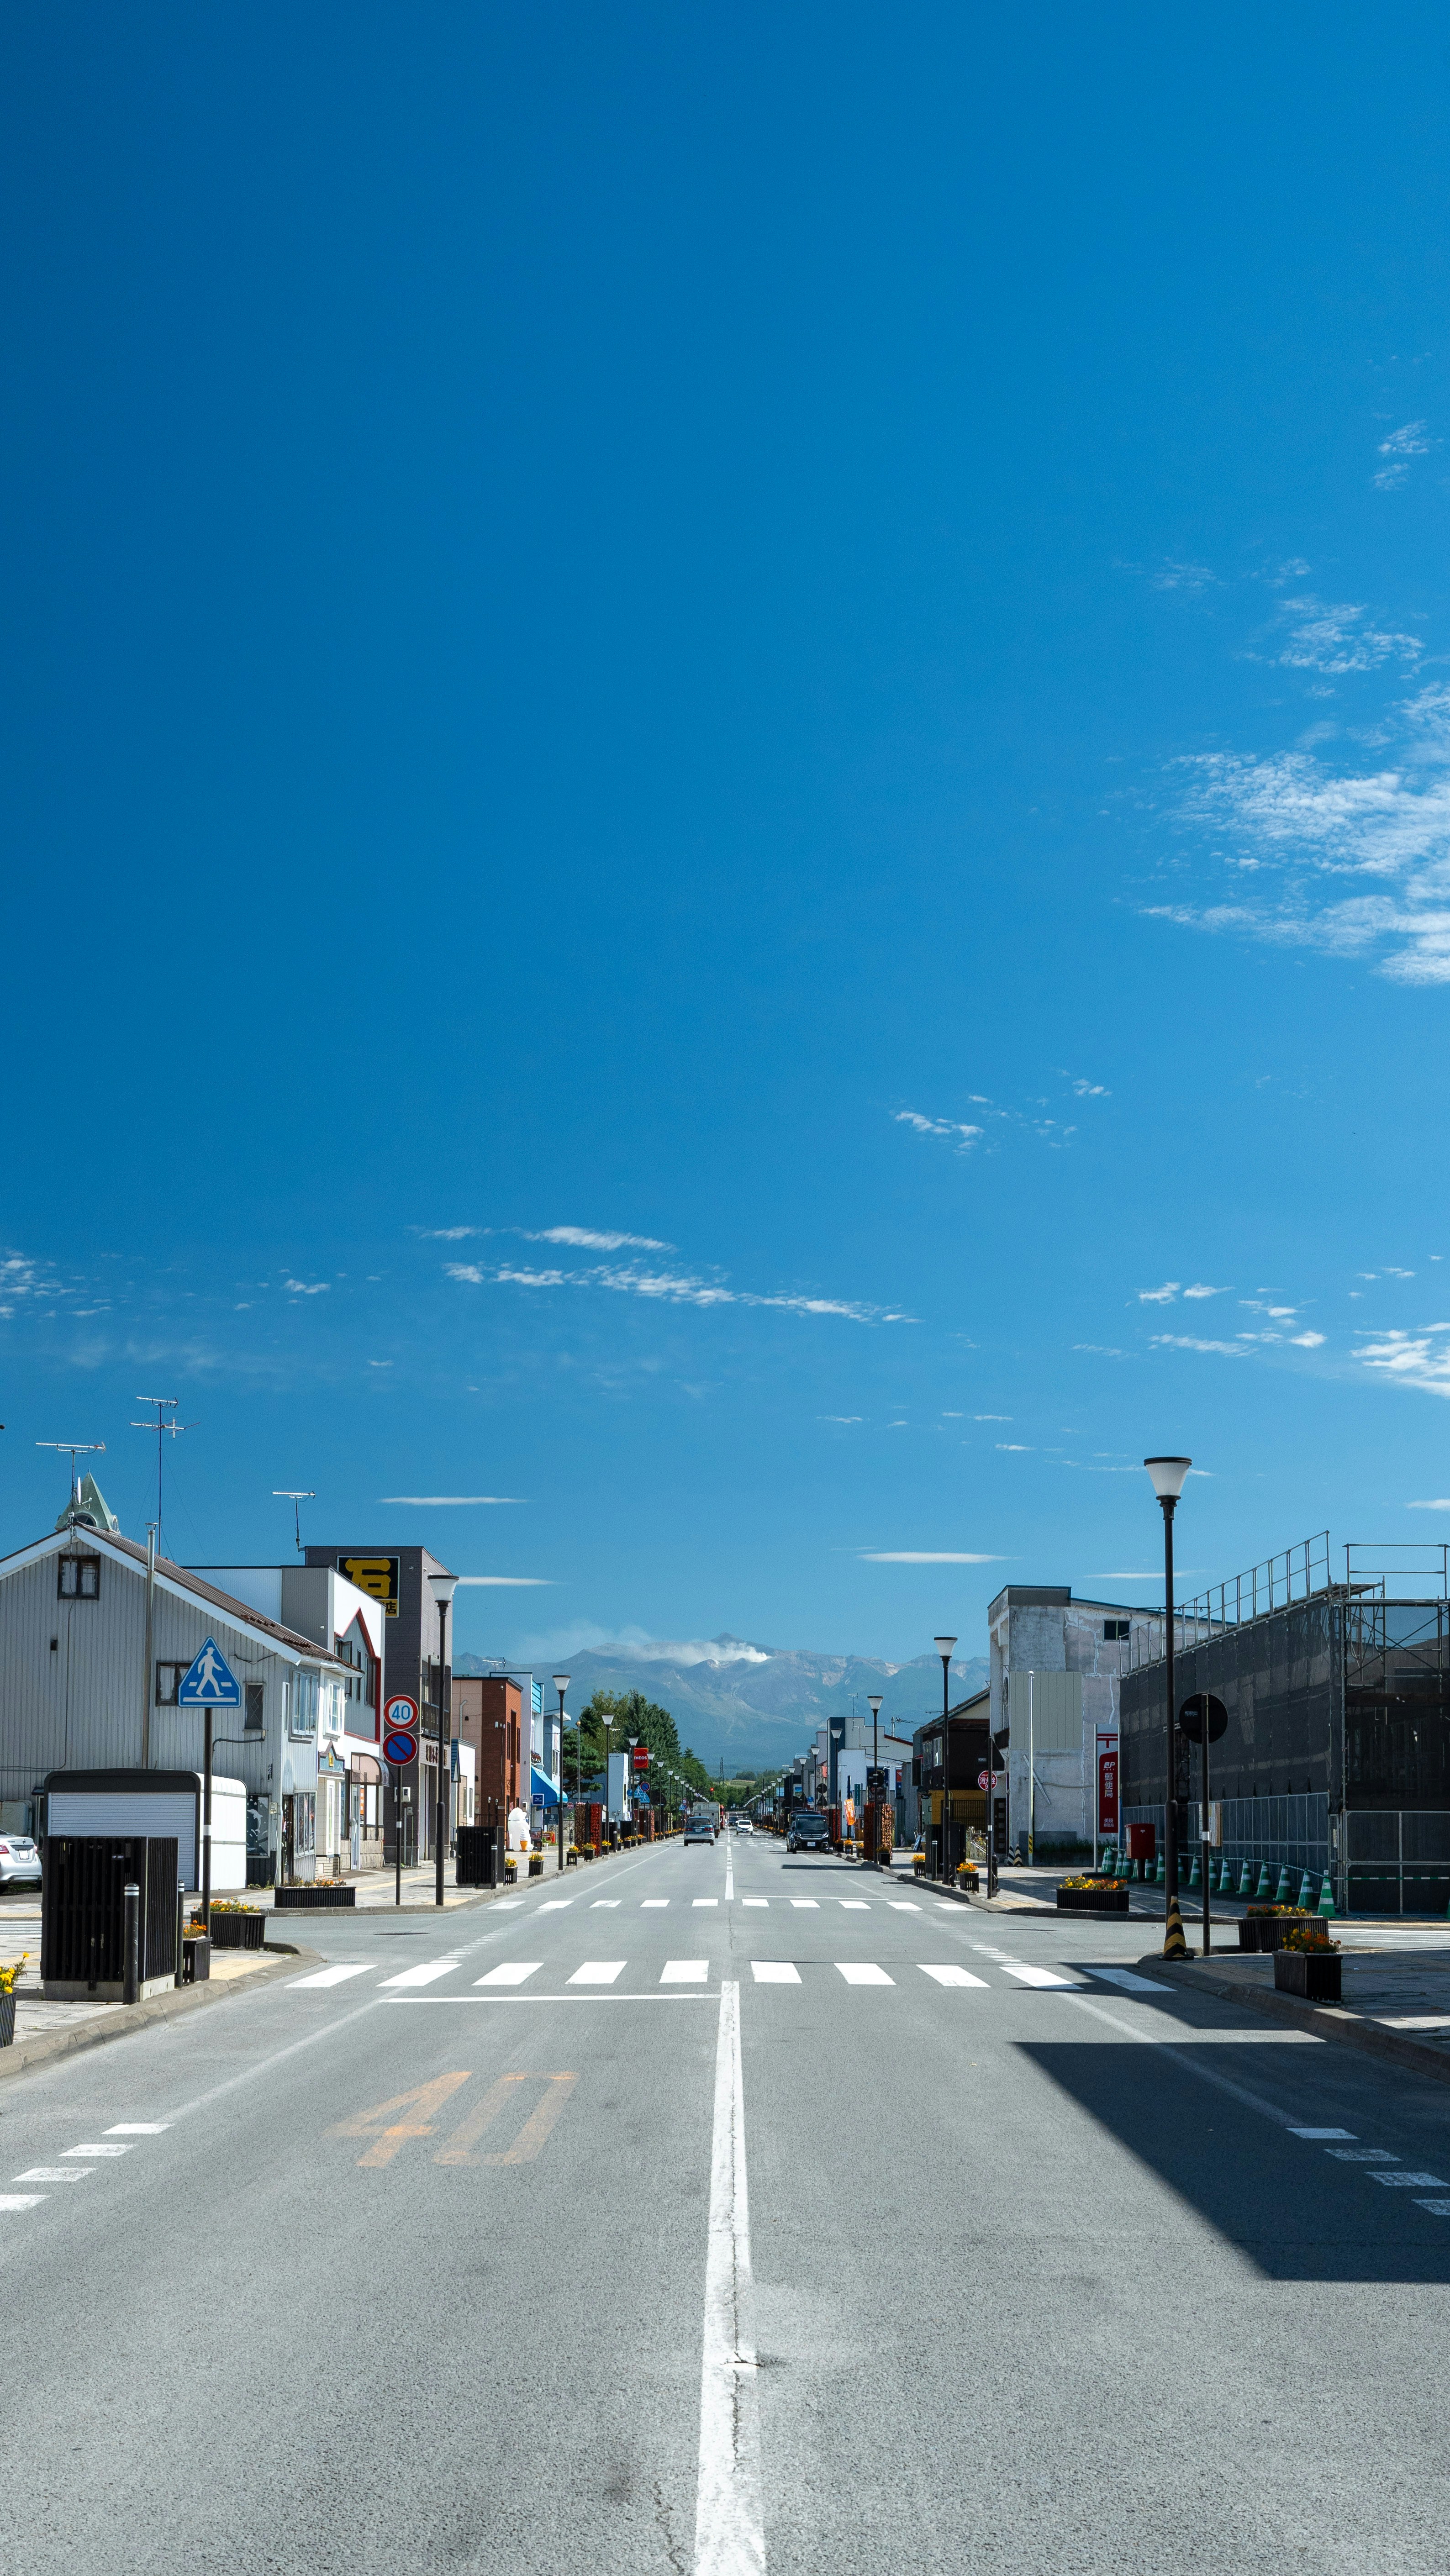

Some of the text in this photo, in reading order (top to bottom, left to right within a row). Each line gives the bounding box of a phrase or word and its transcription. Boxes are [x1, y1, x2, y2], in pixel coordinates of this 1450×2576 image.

[345, 1558, 391, 1598] 石
[391, 1705, 410, 1720] 40
[1104, 1772, 1113, 1798] 郵便局
[320, 2070, 580, 2168] 40
